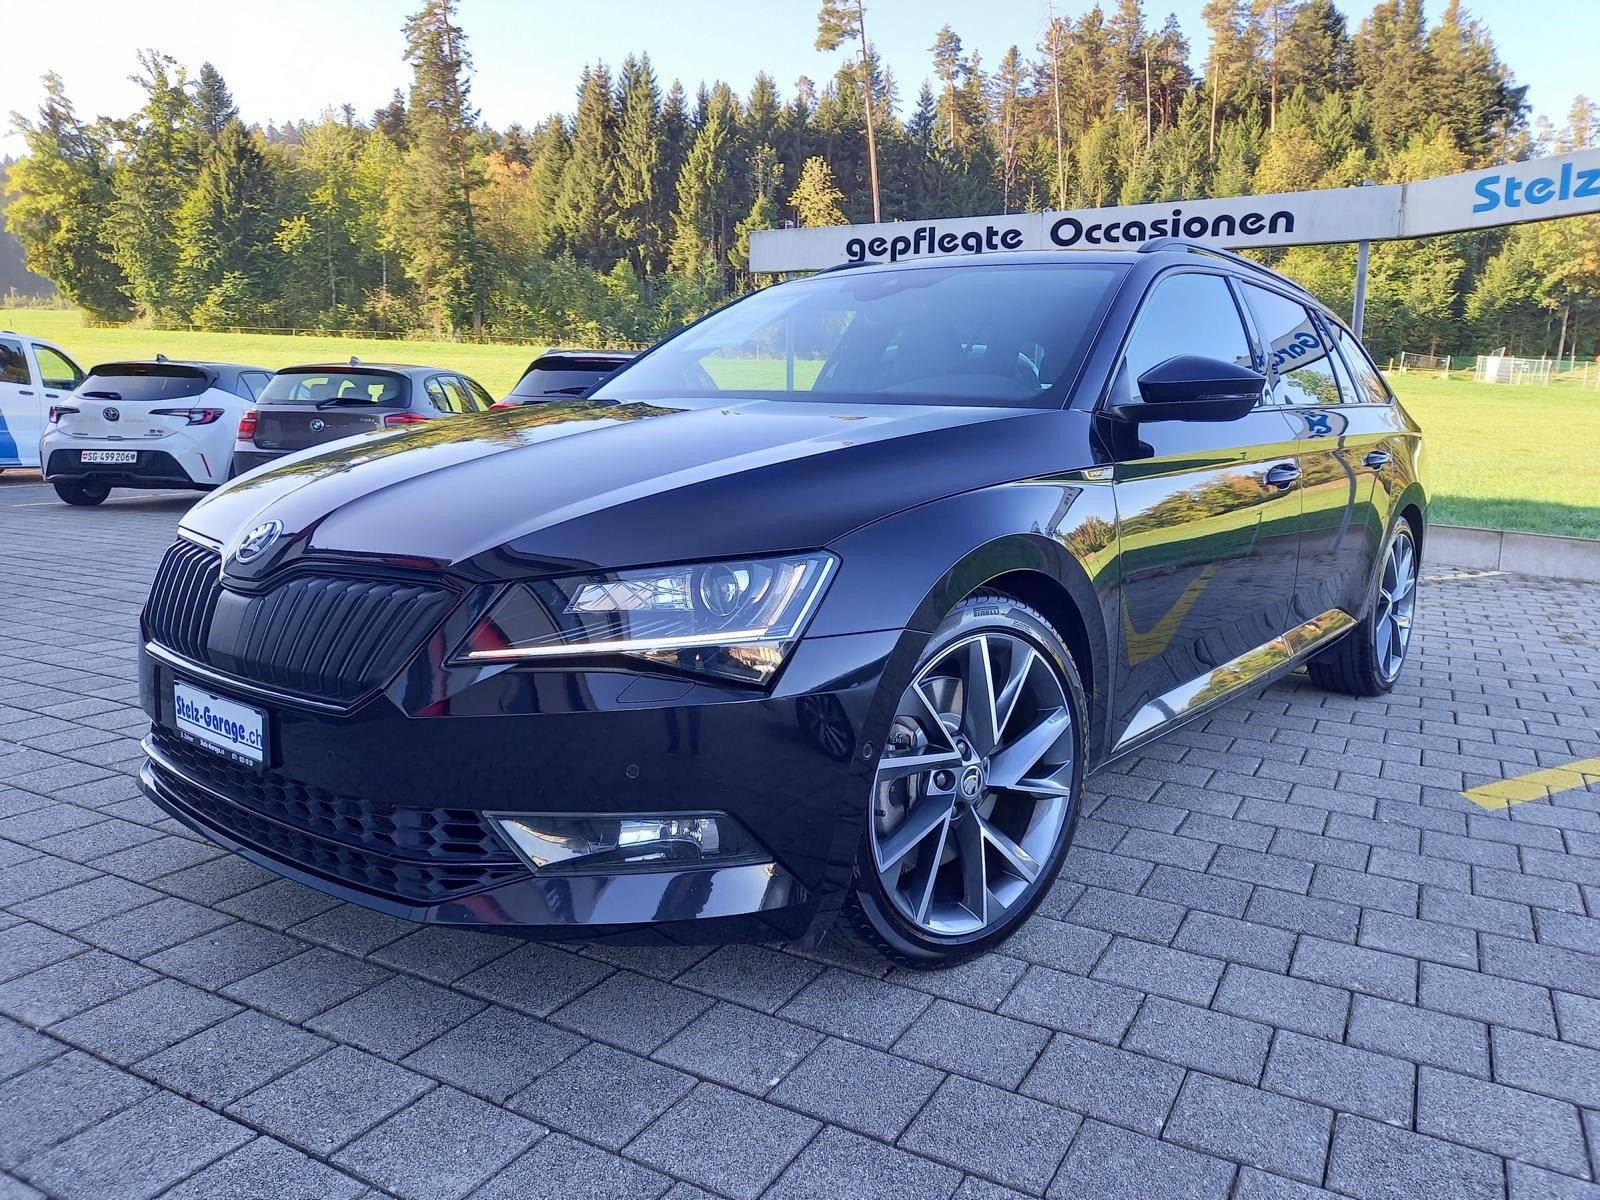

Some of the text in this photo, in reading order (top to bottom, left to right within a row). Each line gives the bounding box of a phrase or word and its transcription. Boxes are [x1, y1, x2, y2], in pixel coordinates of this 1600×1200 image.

[1472, 162, 1600, 213] Stelz
[846, 209, 1295, 262] gepflegte Occasionen
[88, 452, 130, 461] SG 499206
[176, 695, 262, 746] Stelz-Garage.ch
